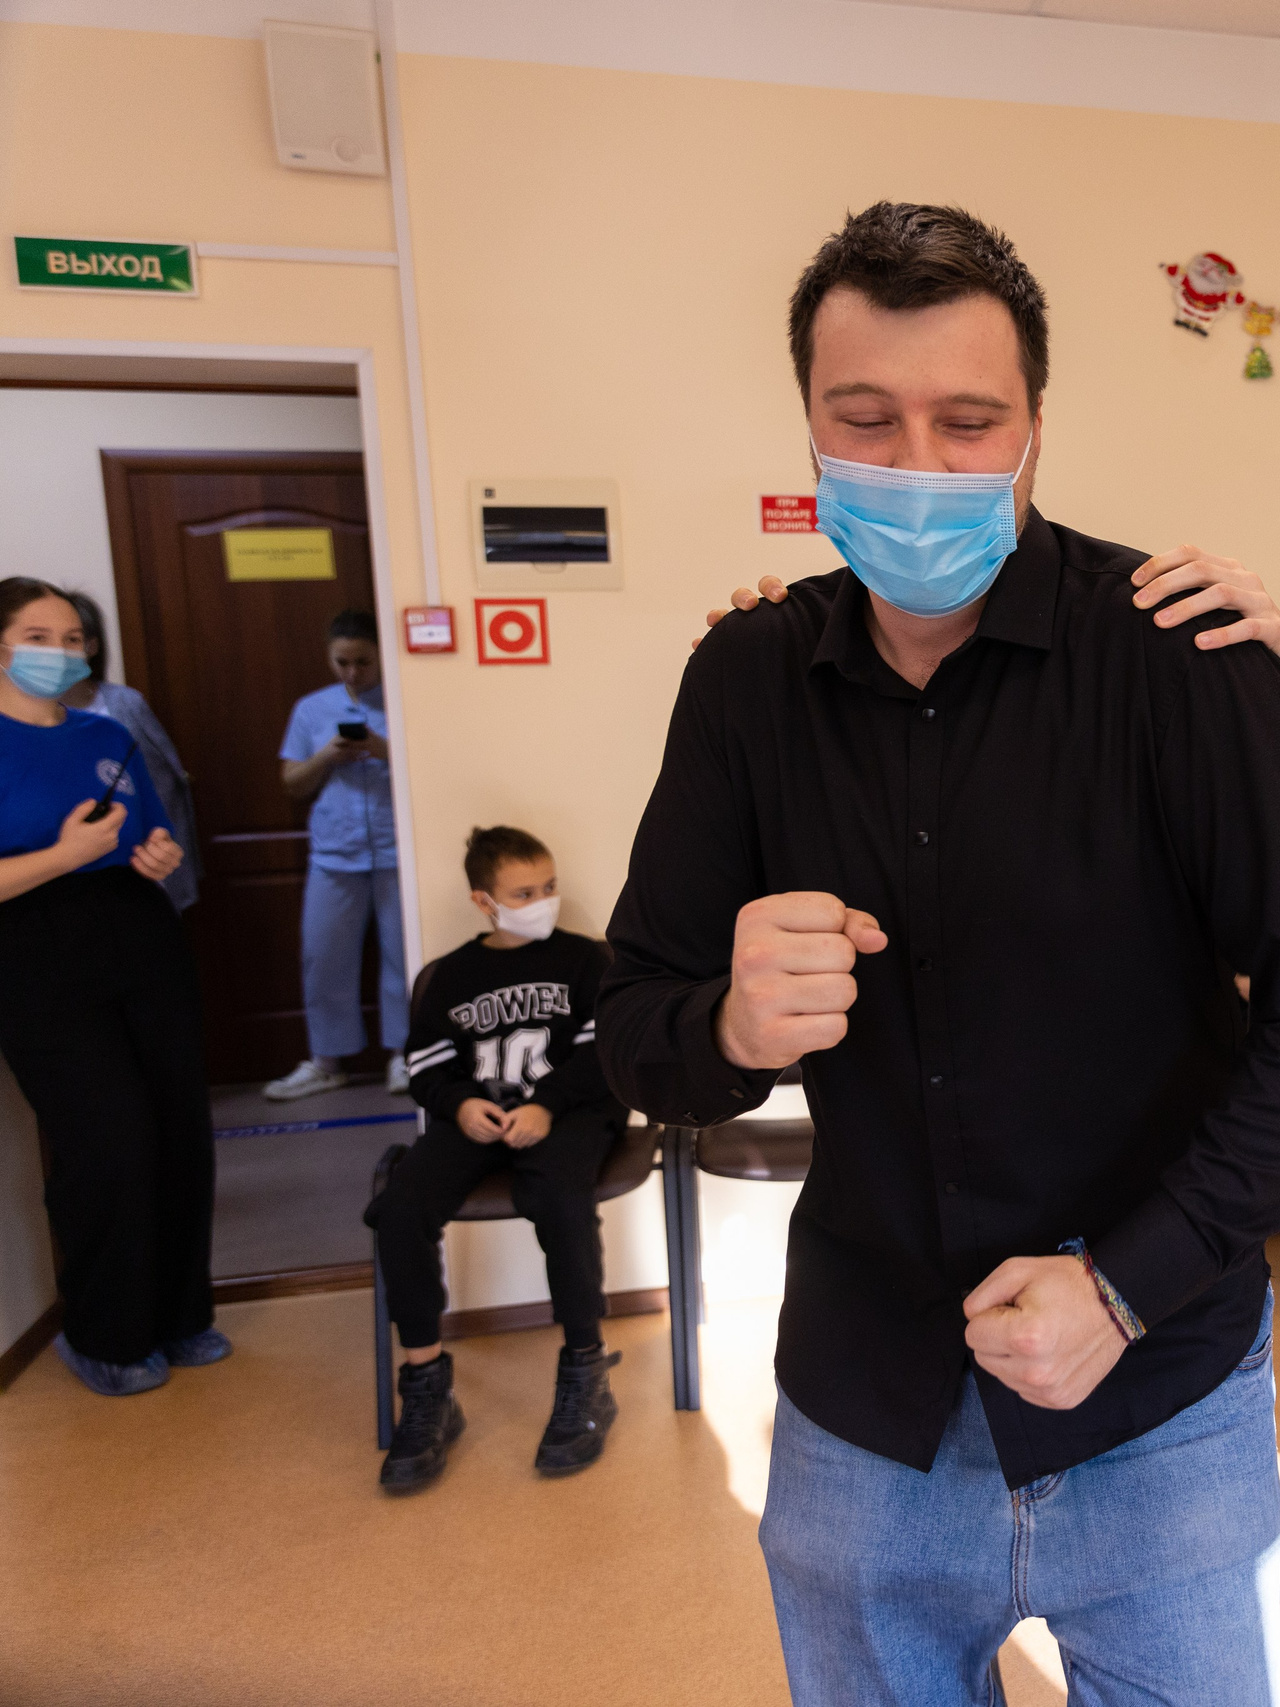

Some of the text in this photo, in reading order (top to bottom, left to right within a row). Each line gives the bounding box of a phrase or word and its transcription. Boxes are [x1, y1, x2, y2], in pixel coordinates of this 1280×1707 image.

[46, 251, 164, 282] ВЫХОД
[775, 497, 799, 508] ПРИ
[763, 509, 812, 520] ПОЖАРЕ
[765, 521, 813, 531] ЗВОНИТЬ
